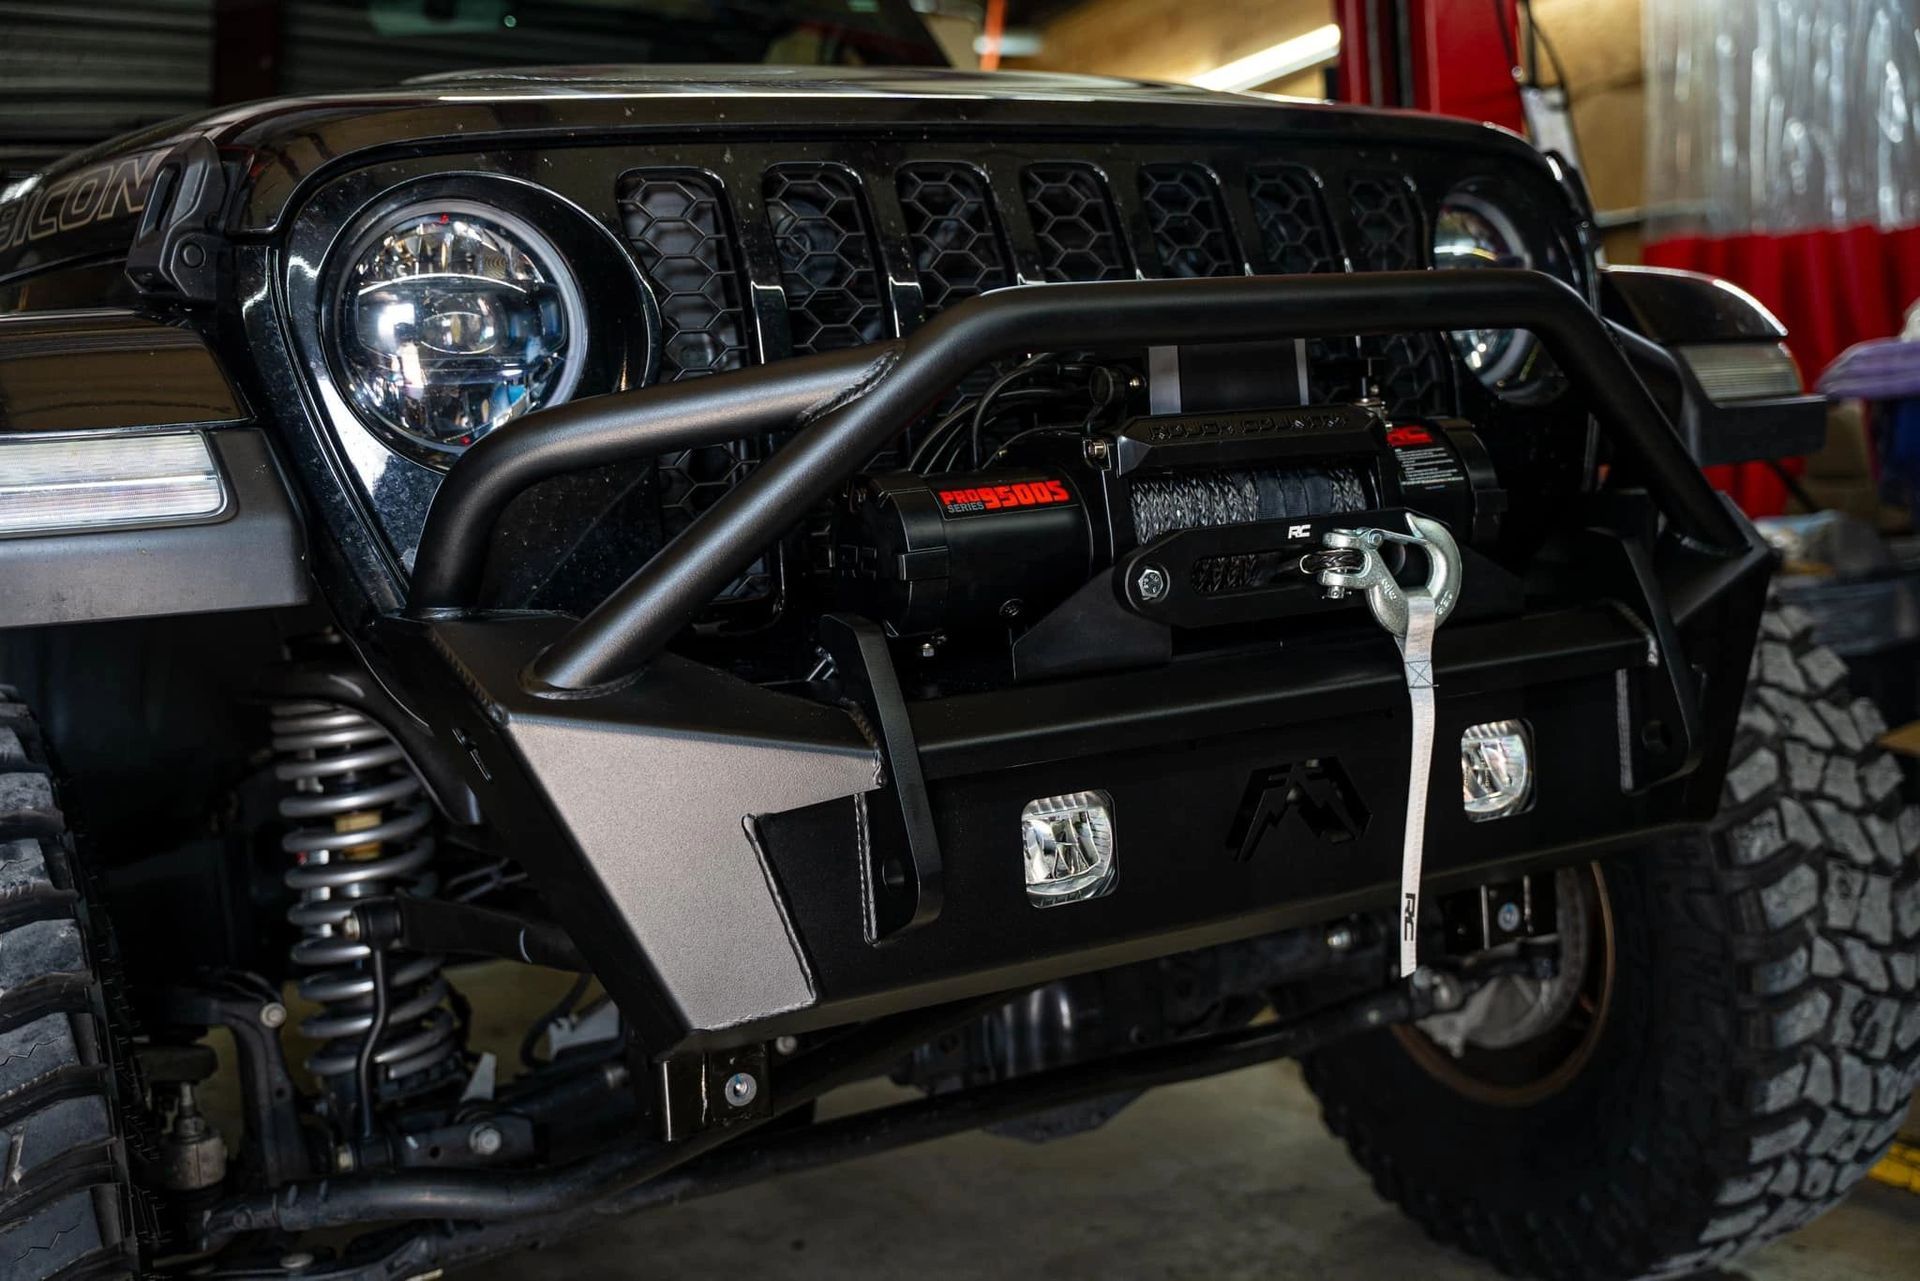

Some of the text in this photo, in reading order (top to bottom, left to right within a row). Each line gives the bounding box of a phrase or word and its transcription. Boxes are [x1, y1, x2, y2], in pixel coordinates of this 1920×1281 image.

[947, 502, 984, 514] SERIES
[1288, 524, 1311, 539] RC
[1404, 893, 1416, 942] RC
